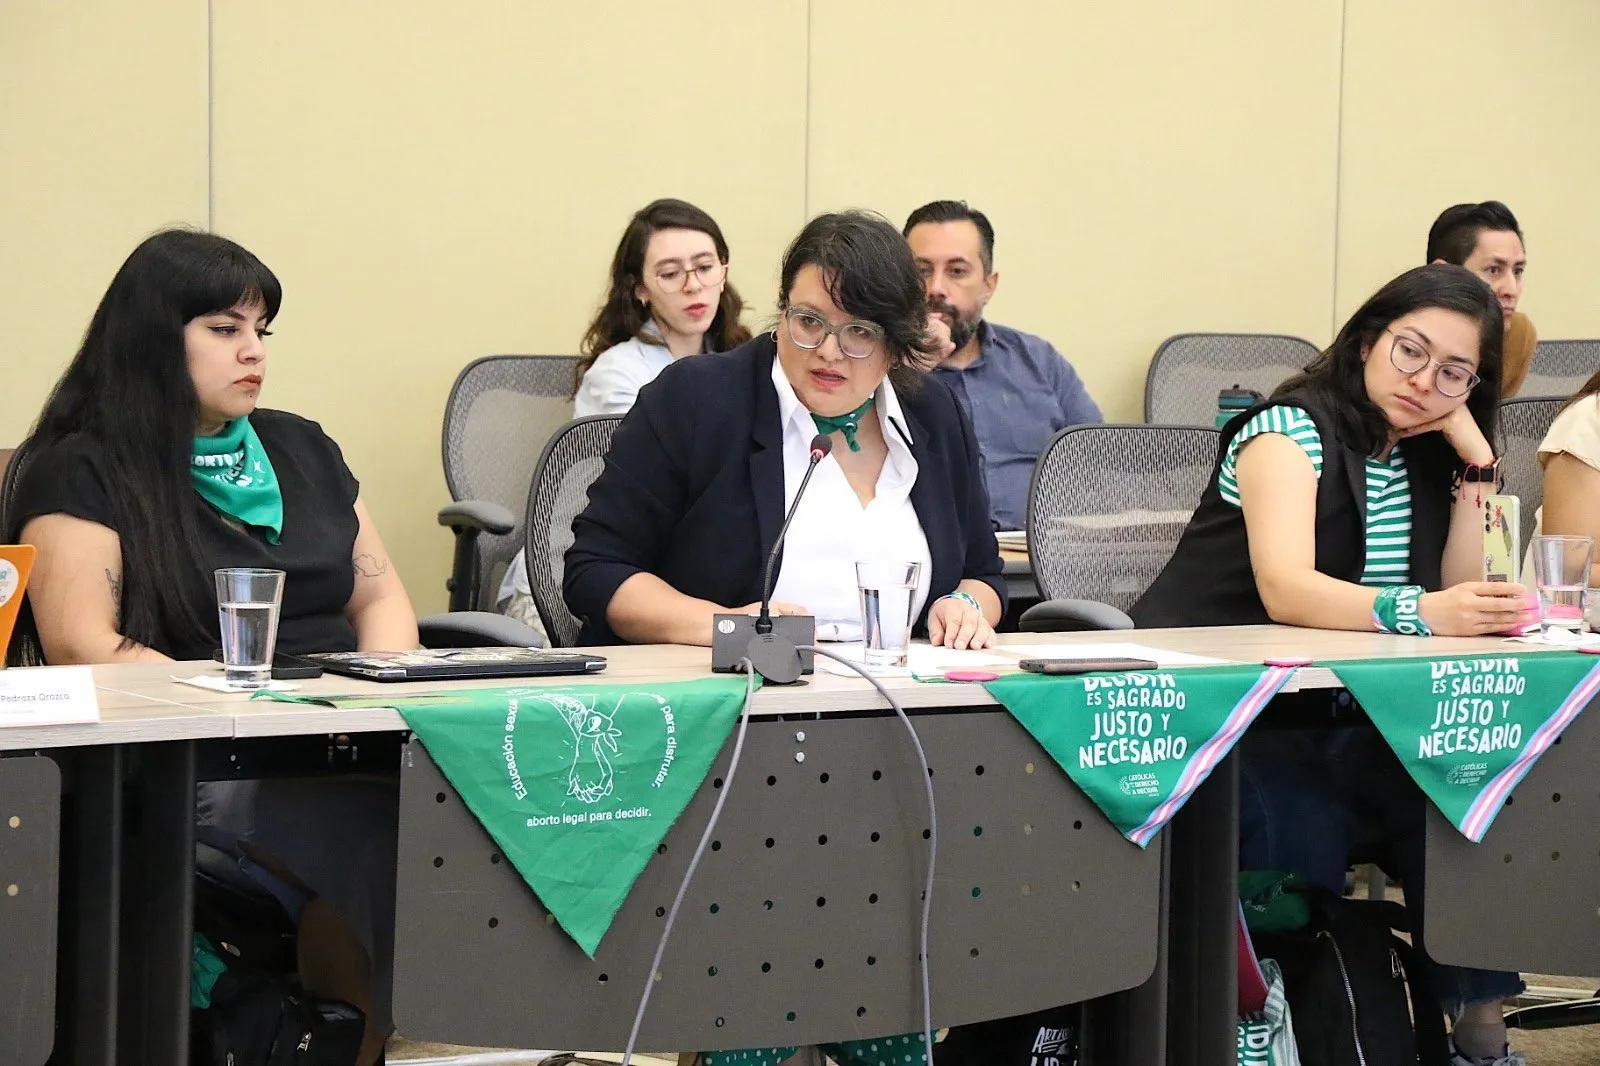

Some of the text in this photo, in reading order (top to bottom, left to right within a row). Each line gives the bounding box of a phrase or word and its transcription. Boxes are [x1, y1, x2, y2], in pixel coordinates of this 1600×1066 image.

[191, 453, 233, 467] ORTO
[38, 692, 70, 701] Orozco
[1086, 687, 1186, 710] ES SAGRADO
[1432, 674, 1526, 698] ES SAGRADO
[1090, 710, 1171, 741] JUSTO Y
[1430, 697, 1510, 730] JUSTO Y
[651, 704, 677, 789] para disfrutar,
[1079, 735, 1188, 769] NECESARIO
[1418, 722, 1522, 759] NECESARIO
[501, 734, 528, 801] Educación
[526, 806, 652, 827] aborto legal para decidir.
